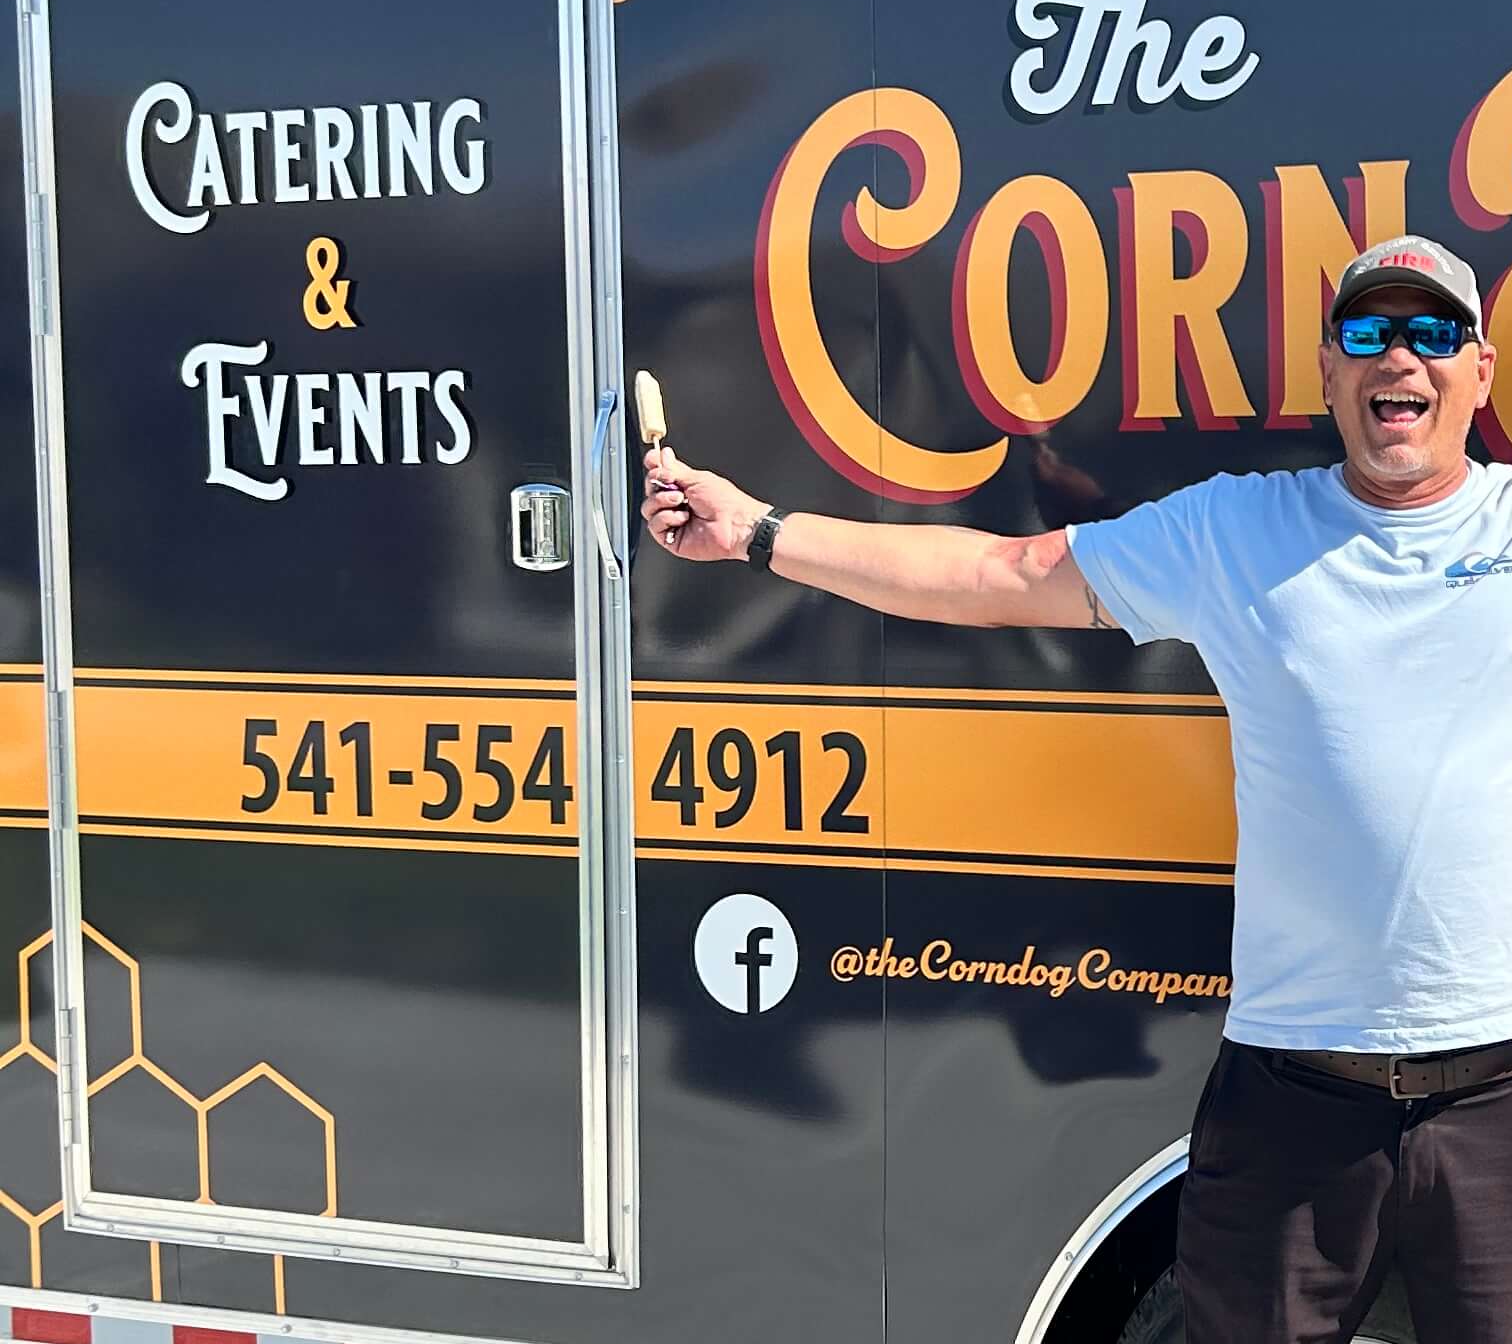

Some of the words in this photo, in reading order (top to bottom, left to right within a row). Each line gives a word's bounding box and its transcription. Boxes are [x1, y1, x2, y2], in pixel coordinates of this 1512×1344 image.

[126, 81, 487, 234] CATERING
[302, 236, 357, 330] &
[180, 339, 472, 501] EVENTS
[830, 937, 1232, 1004] @theCorndogCompan
